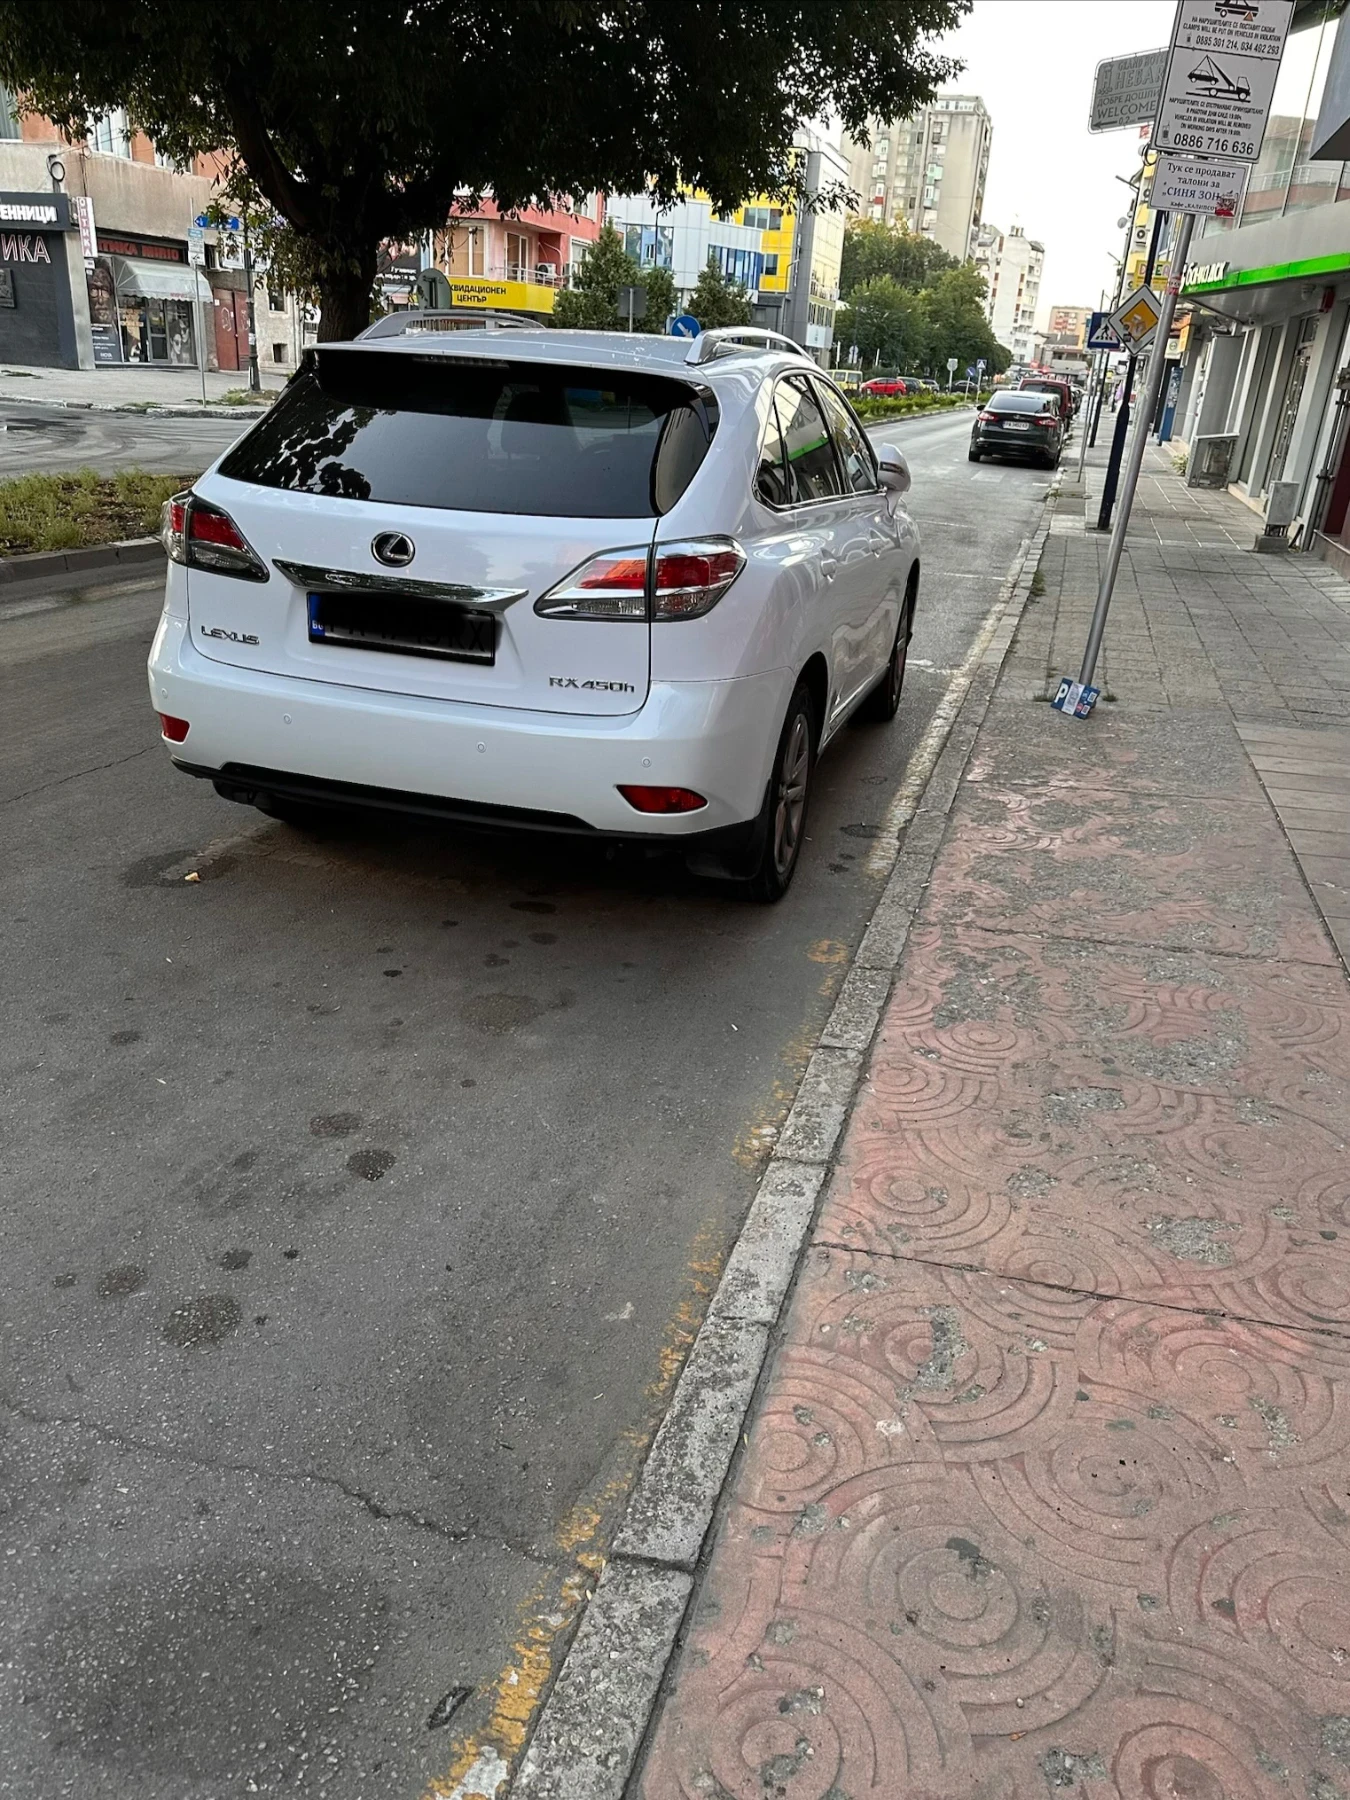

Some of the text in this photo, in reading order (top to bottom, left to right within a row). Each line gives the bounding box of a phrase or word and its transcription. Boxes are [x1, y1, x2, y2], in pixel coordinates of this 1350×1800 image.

[1183, 23, 1201, 31] CLAMPS
[1234, 29, 1253, 38] VEHICLES
[1259, 32, 1281, 42] VIOLATION
[1097, 95, 1123, 108] ДОБРЕ
[1097, 100, 1156, 119] WELCOME
[1175, 114, 1194, 122] VEHICLES
[1199, 117, 1217, 125] VIOLATION
[1215, 126, 1227, 134] AFTER
[1174, 133, 1254, 155] 0886 716 636
[1167, 162, 1182, 175] Тук
[1195, 167, 1236, 179] продават
[1177, 176, 1220, 189] талони за
[1198, 190, 1221, 201] ЗОН
[80, 197, 92, 257] ОПТИКА
[0, 233, 51, 264] ИКА
[201, 626, 260, 645] LEXUS
[549, 677, 634, 693] RX450h
[1054, 683, 1069, 703] P
